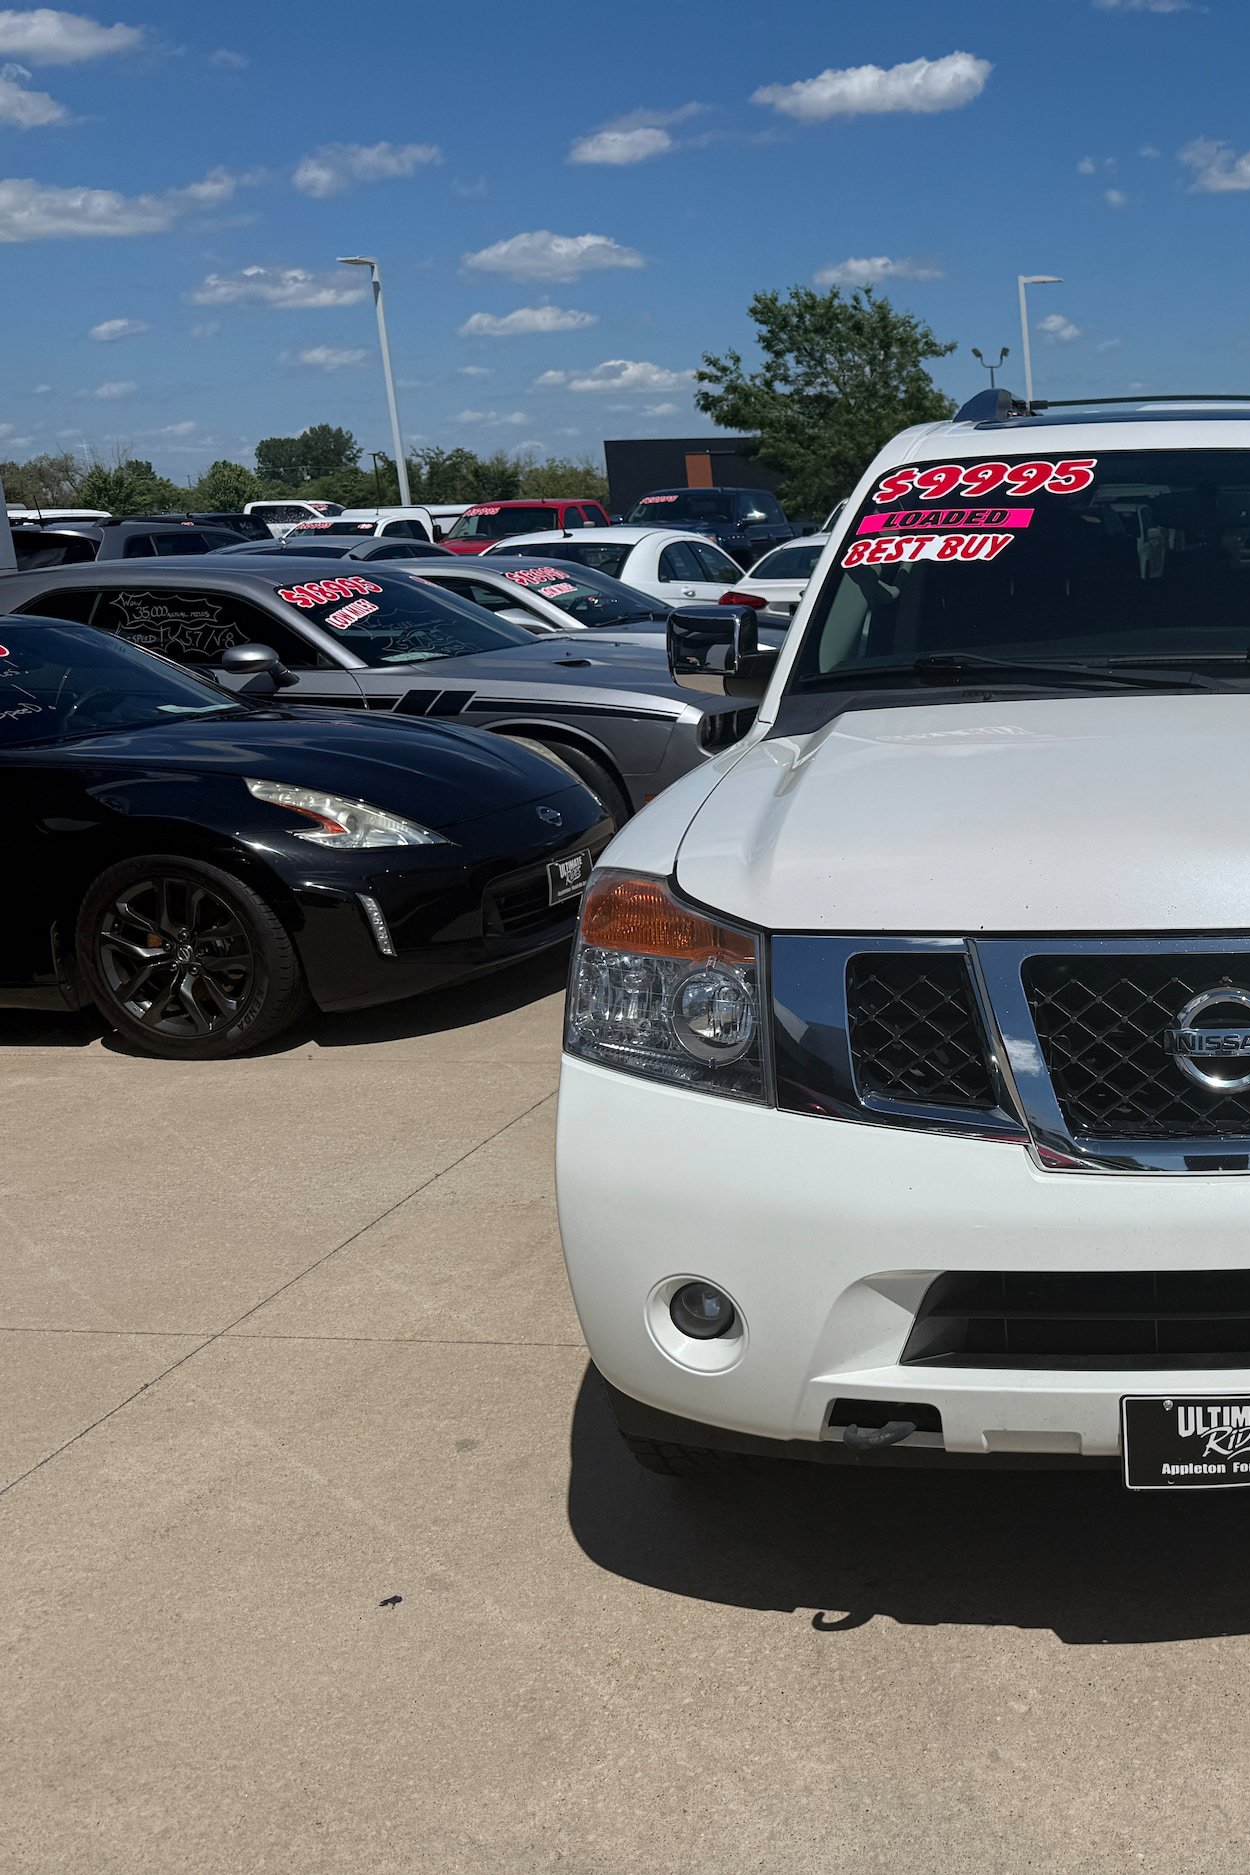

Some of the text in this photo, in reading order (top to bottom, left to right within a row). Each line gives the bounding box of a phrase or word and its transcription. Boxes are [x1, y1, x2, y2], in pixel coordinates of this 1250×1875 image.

[872, 459, 1097, 503] $9995
[882, 509, 1012, 529] LOADED
[841, 534, 1014, 568] BEST BUY
[278, 576, 383, 608] $18995
[325, 599, 379, 629] LOW MILES
[1162, 1462, 1226, 1475] Appleton
